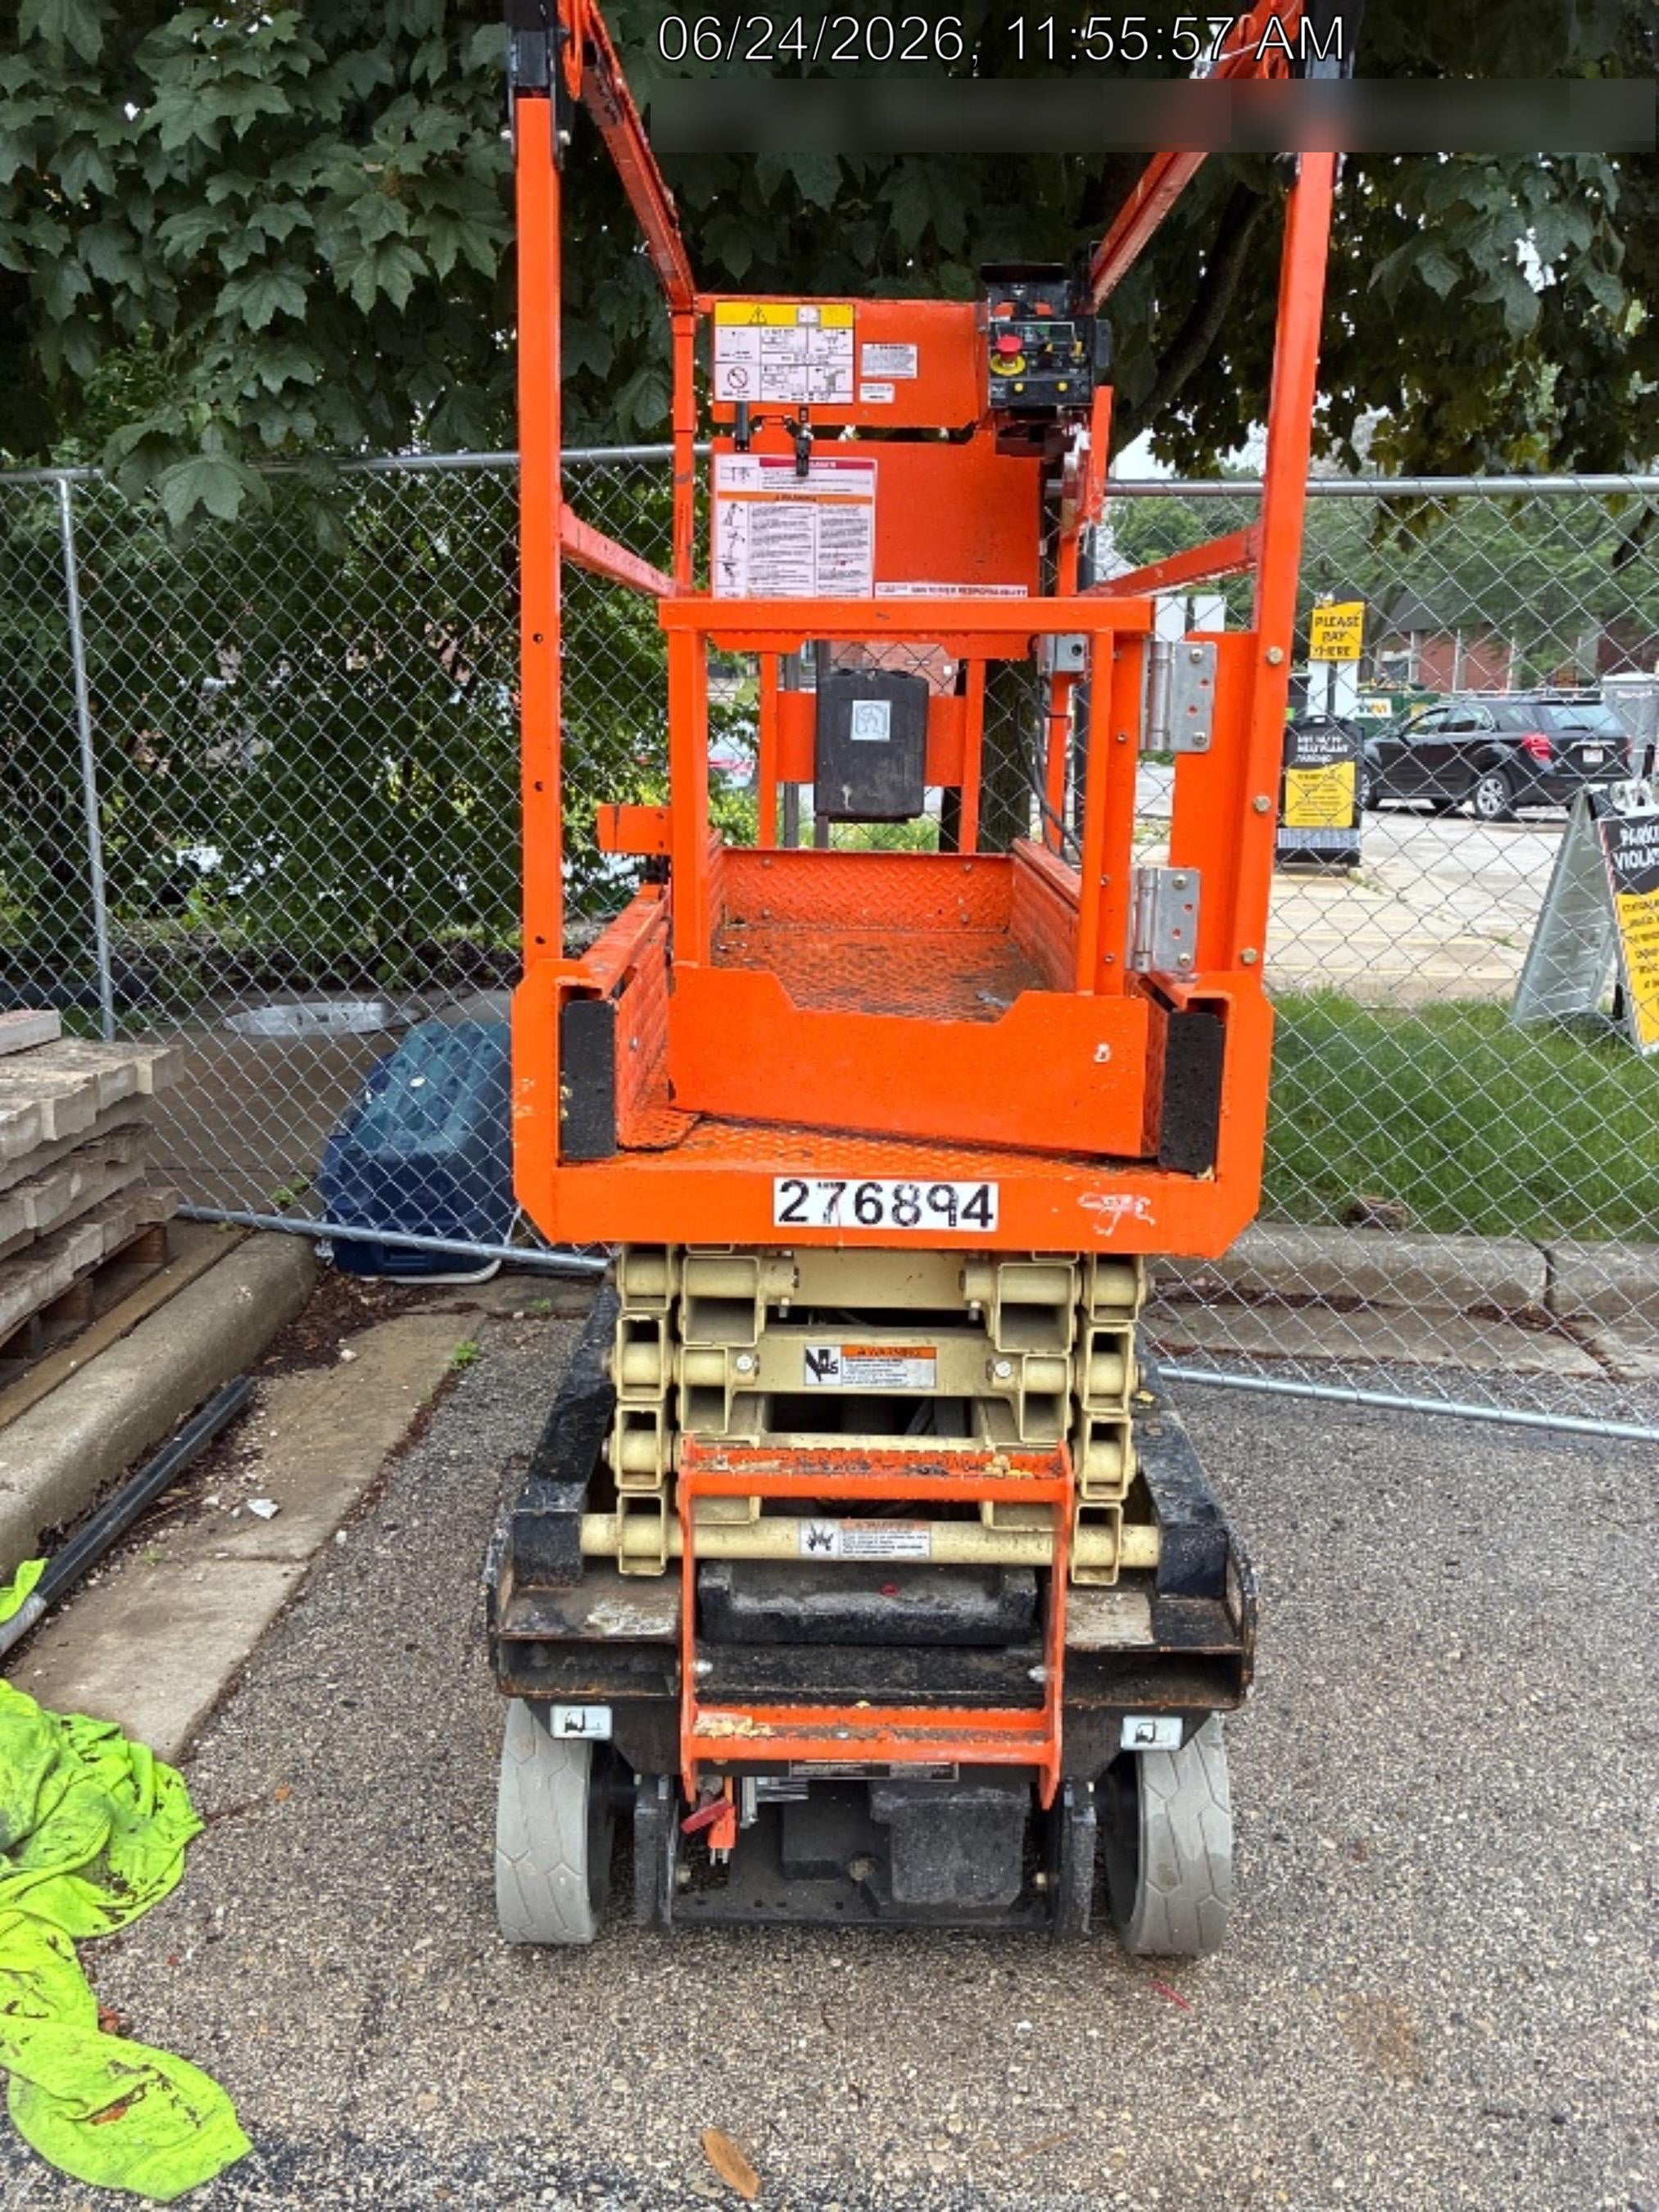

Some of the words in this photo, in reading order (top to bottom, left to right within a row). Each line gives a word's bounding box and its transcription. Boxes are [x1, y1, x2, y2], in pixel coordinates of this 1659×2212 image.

[1315, 616, 1360, 628] PLEASE
[1322, 631, 1344, 642] PAY
[1320, 646, 1351, 656] HERE
[777, 1178, 995, 1228] 276894
